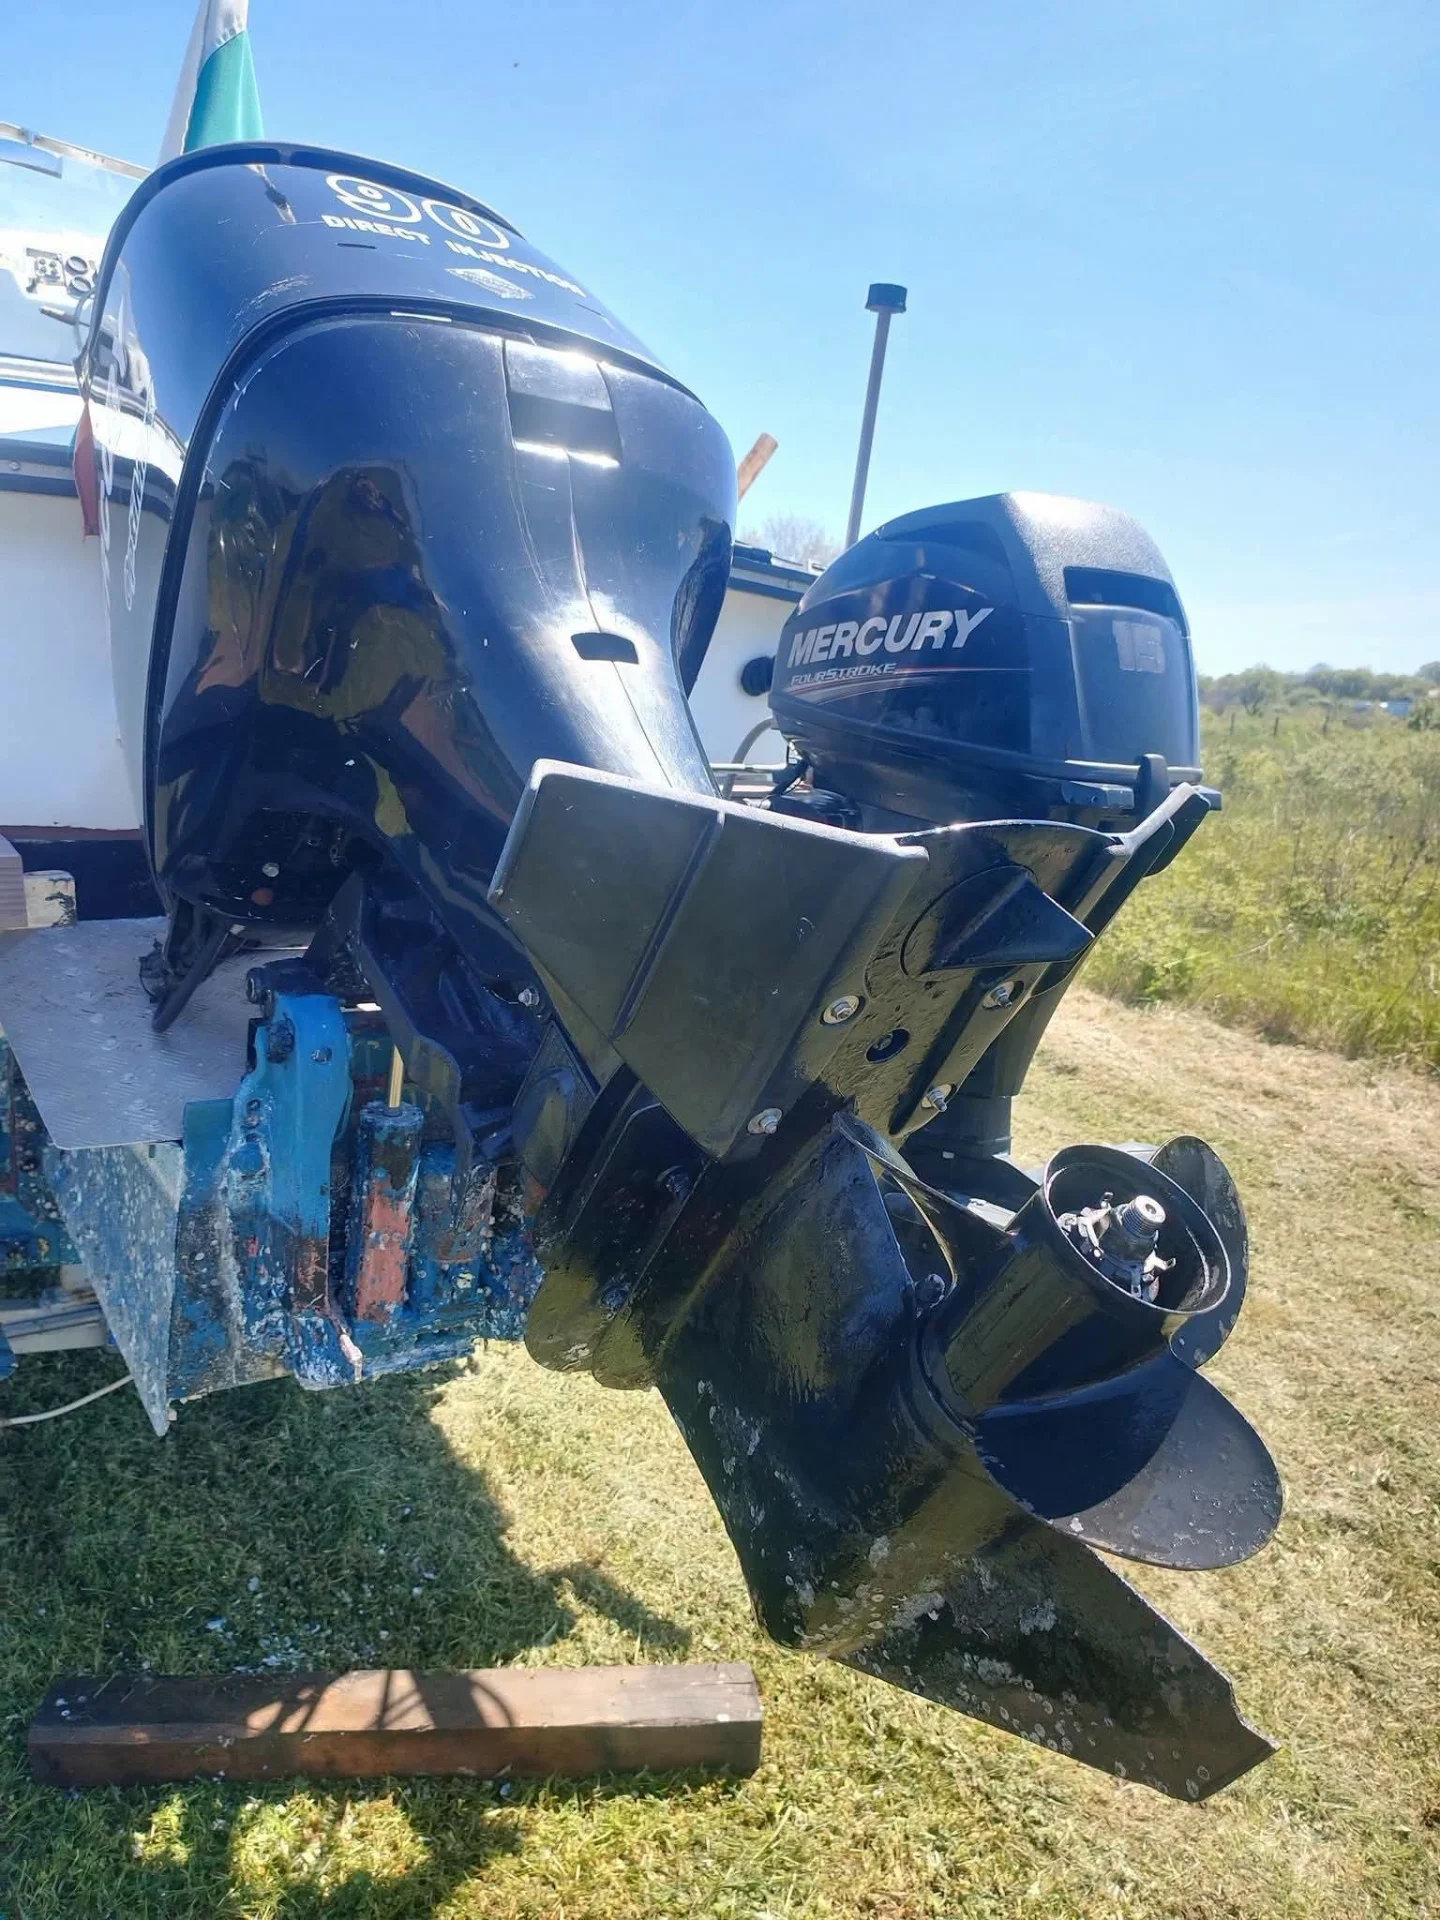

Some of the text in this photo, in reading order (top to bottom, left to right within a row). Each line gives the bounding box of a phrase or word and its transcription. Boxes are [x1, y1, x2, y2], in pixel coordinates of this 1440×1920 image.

[326, 174, 509, 249] 90
[321, 215, 430, 245] DIRECT
[445, 240, 587, 298] INJECTION
[787, 607, 995, 669] MERCURY
